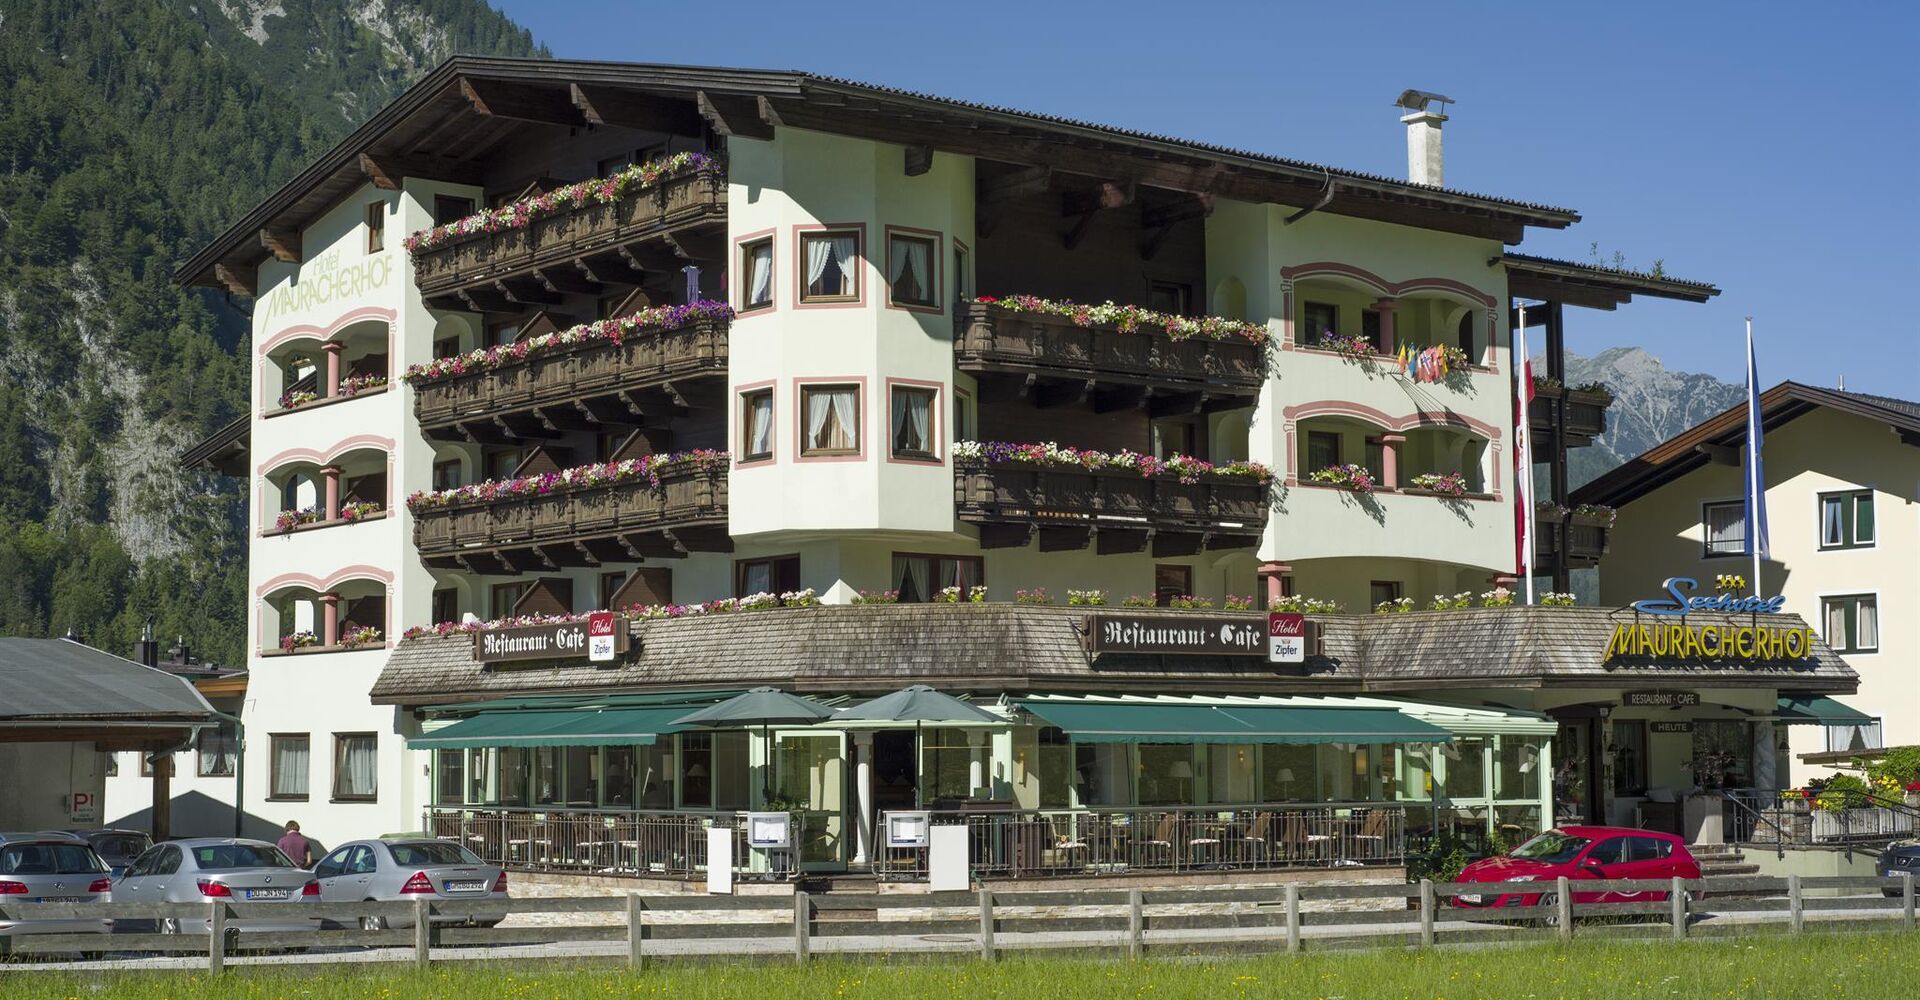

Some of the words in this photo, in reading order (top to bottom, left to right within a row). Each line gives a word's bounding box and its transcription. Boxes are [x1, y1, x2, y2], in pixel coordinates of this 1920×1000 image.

[313, 249, 340, 276] Hotel
[262, 255, 393, 334] MAURACHERHOF
[1630, 576, 1786, 616] Seehotel
[591, 618, 613, 634] Hotel
[1271, 619, 1302, 634] Hotel
[1275, 644, 1298, 657] Zipfer
[1603, 624, 1816, 662] MAURACHERHOF
[1631, 694, 1672, 704] RESTAURANT
[1677, 694, 1695, 704] CAFE
[1658, 723, 1687, 731] HEUTE
